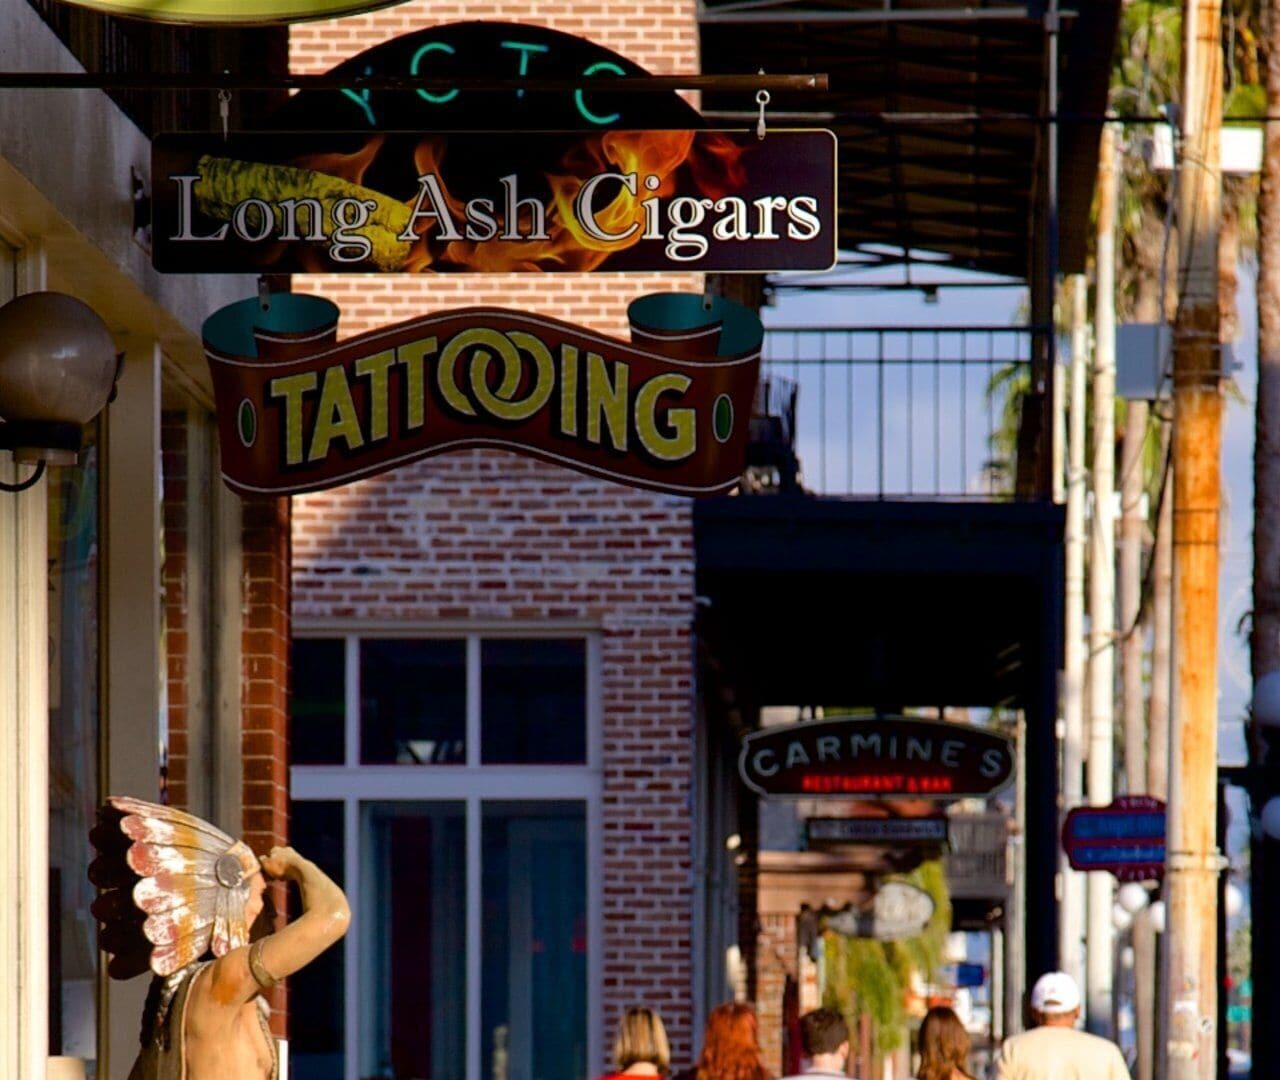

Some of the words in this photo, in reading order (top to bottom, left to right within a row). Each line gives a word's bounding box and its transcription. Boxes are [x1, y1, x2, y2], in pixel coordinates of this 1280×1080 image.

[169, 174, 377, 262] Long
[398, 170, 552, 242] Ash
[575, 171, 821, 263] Cigars
[270, 327, 698, 468] TATTOOING
